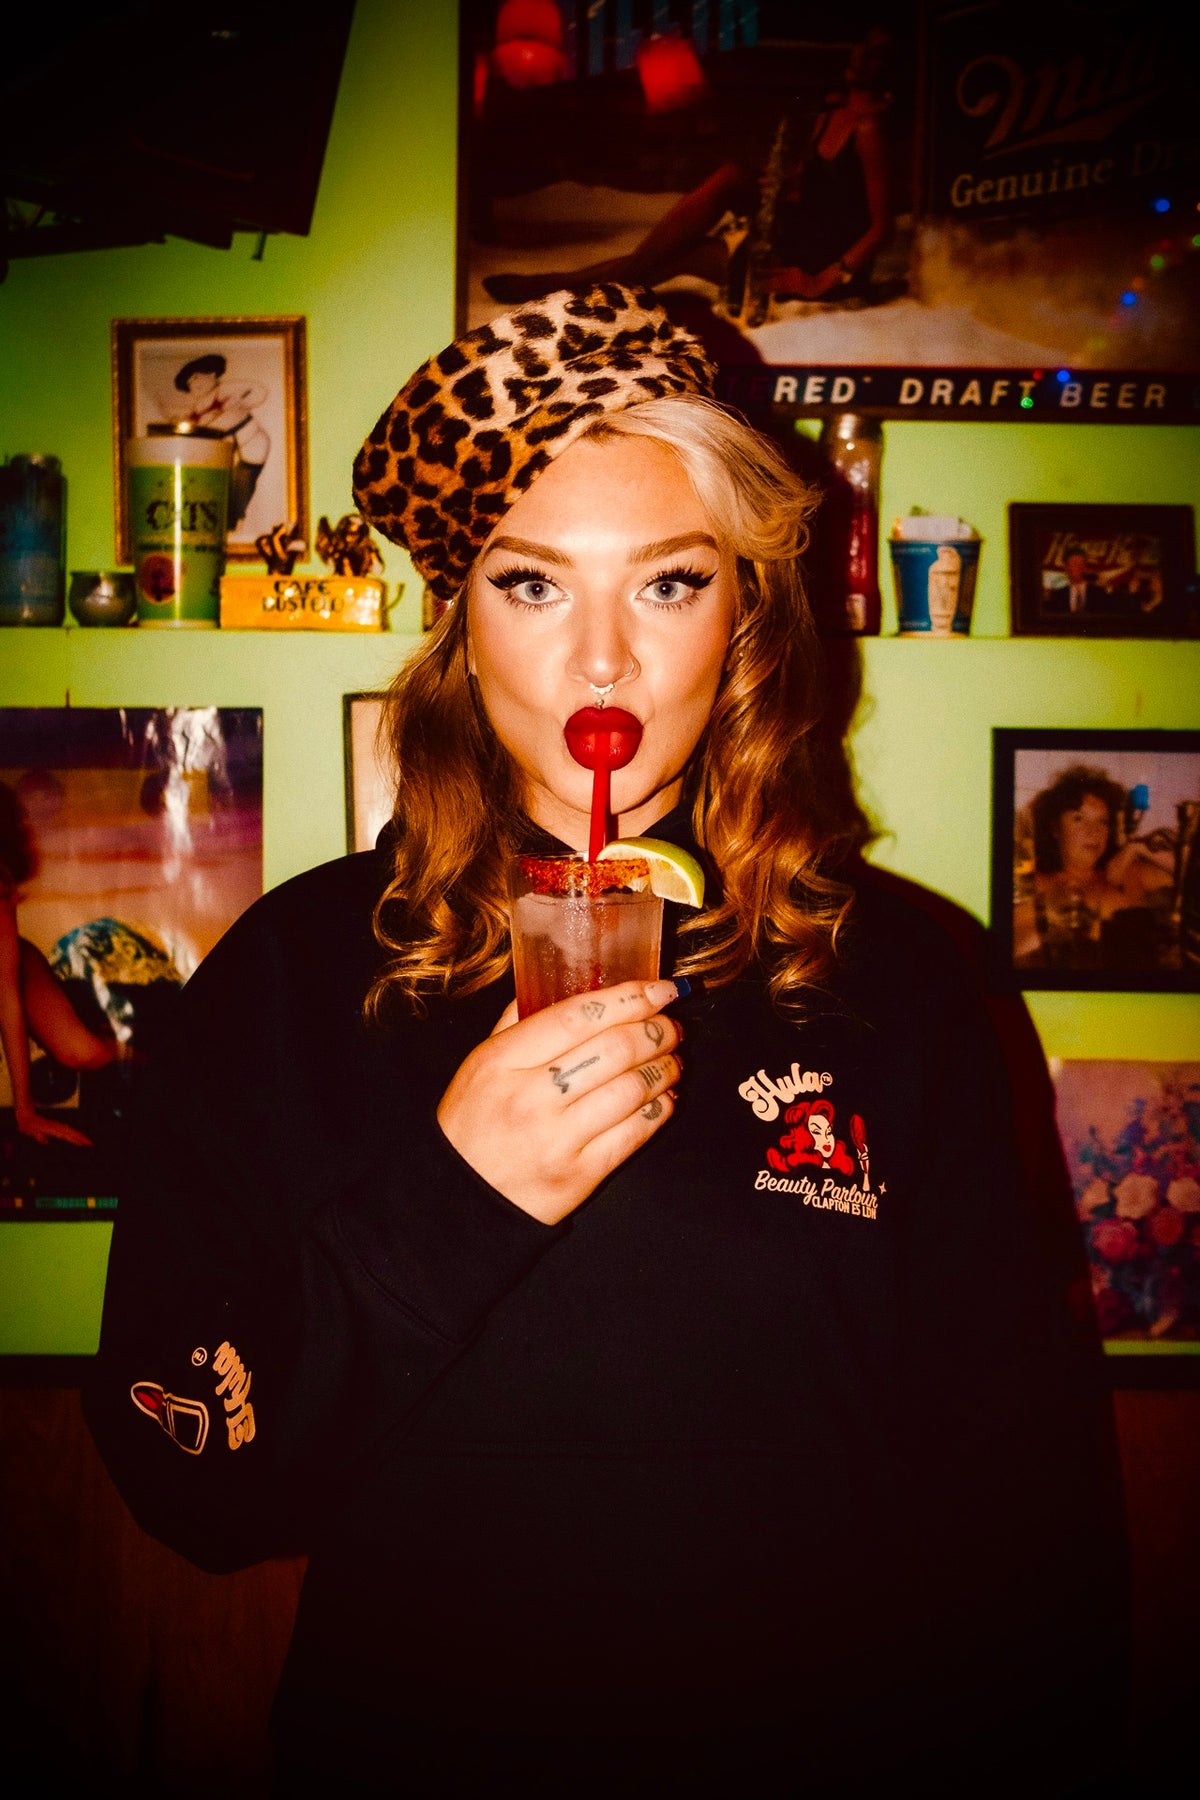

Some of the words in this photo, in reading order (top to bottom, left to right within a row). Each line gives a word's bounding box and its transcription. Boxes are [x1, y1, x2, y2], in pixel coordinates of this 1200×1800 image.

[950, 158, 1116, 208] Genuine
[899, 376, 1040, 408] DRAFT
[1058, 382, 1168, 410] BEER
[754, 1169, 818, 1206] Beauty
[821, 1178, 878, 1208] Parlour
[812, 1195, 850, 1213] CLAPTON
